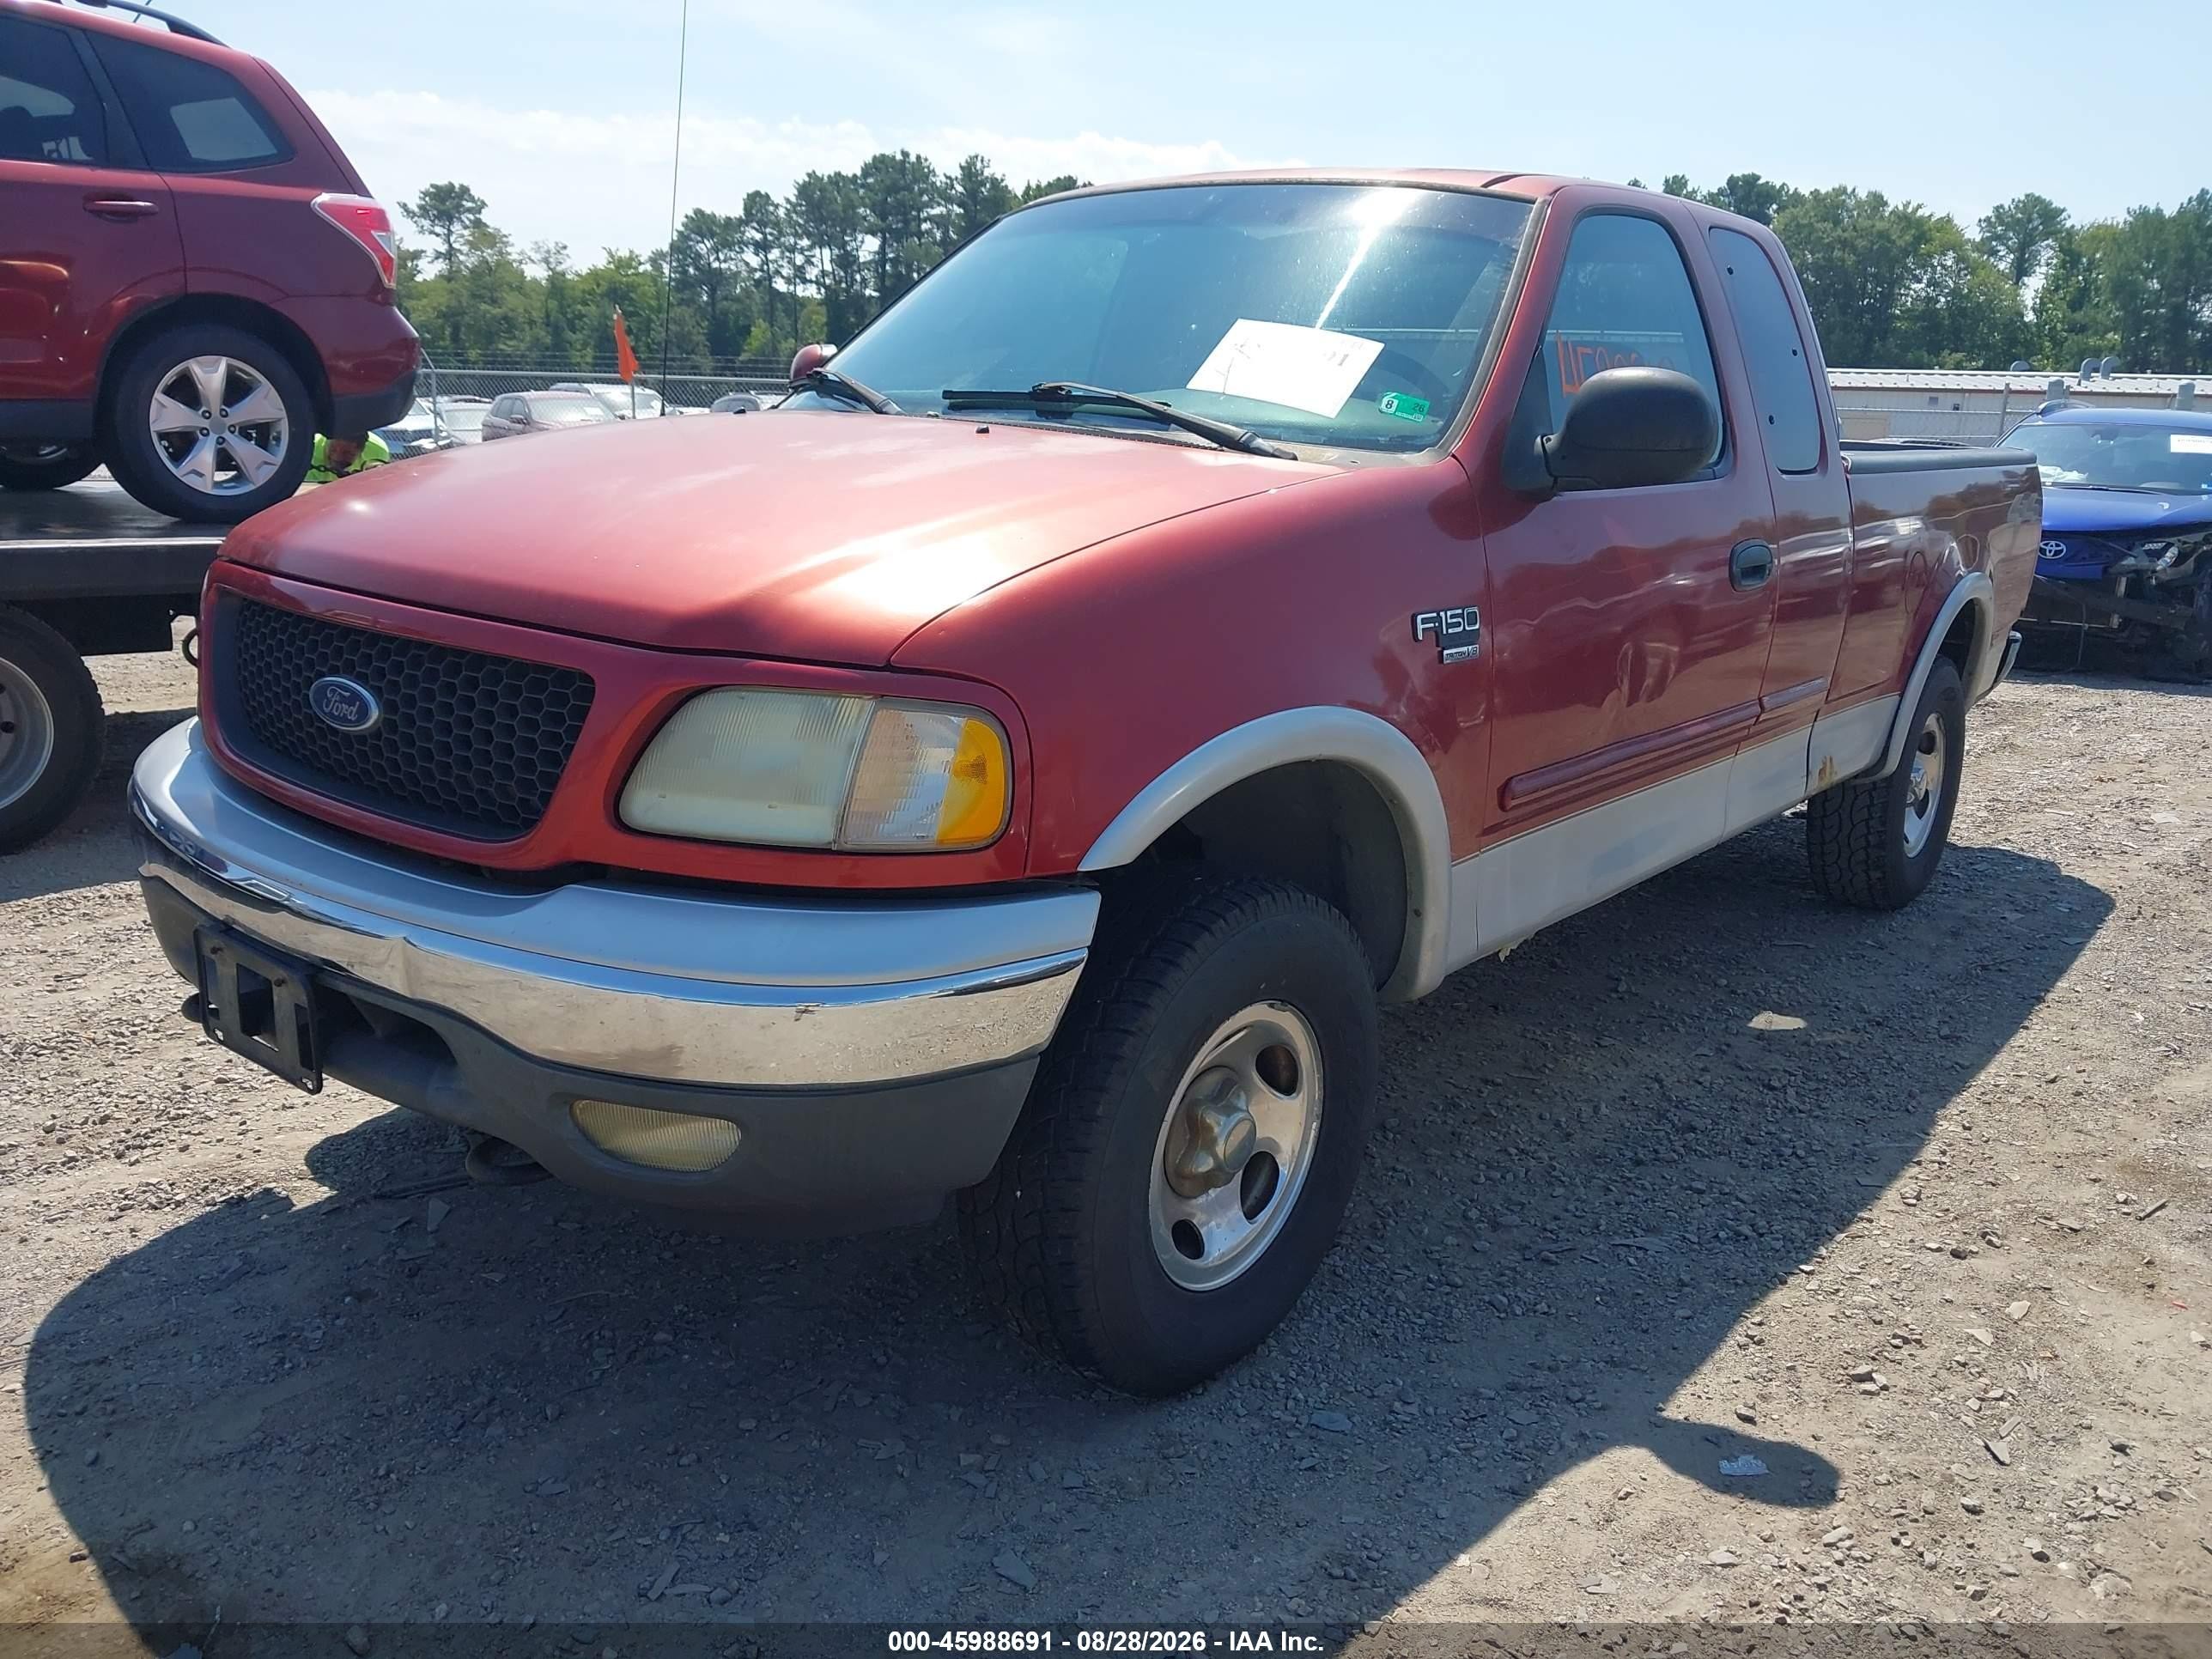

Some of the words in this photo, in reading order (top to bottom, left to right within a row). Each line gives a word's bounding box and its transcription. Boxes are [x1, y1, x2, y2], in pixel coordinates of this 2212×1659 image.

[1385, 399, 1395, 410] 8
[1444, 650, 1467, 661] TRITON
[1466, 646, 1478, 658] V8
[323, 686, 360, 721] Ford
